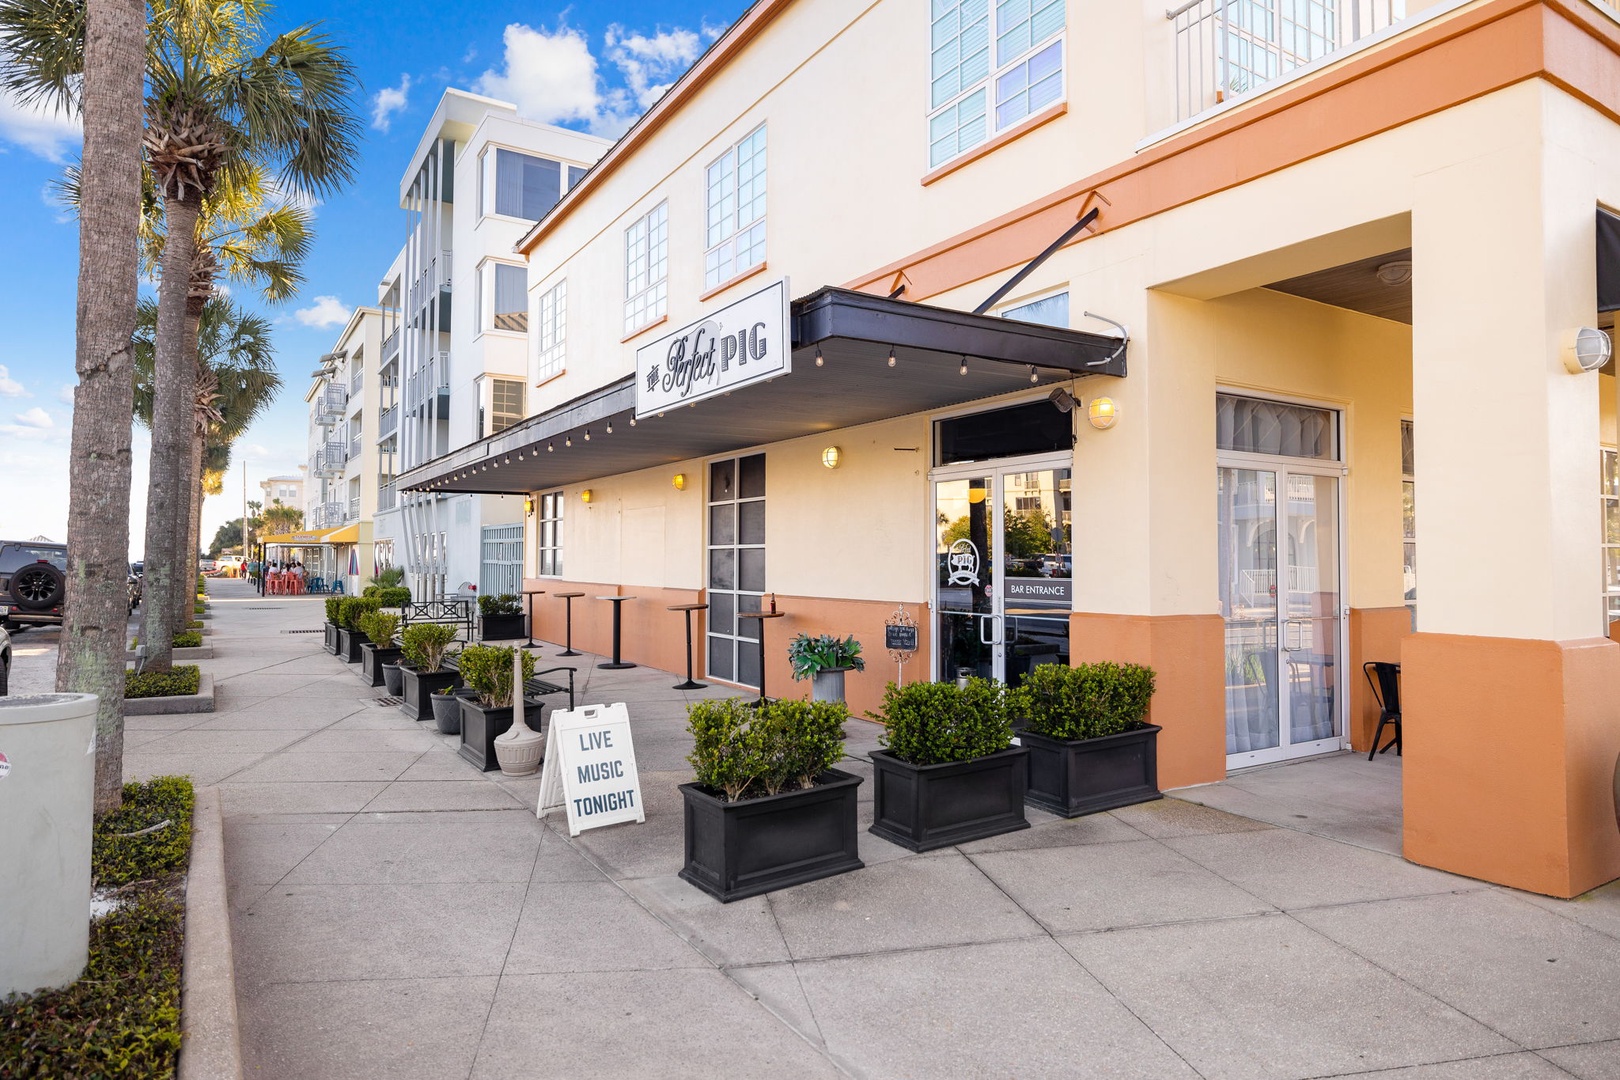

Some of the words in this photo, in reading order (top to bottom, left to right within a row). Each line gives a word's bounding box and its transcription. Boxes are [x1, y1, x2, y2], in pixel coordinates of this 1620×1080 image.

[662, 327, 716, 397] Perfect
[721, 322, 767, 372] PIG
[957, 555, 972, 565] PIG
[1010, 584, 1024, 594] BAR
[1025, 585, 1065, 596] ENTRANCE
[579, 730, 613, 752] LIVE
[577, 760, 624, 784] MUSIC
[573, 789, 635, 817] TONIGHT
